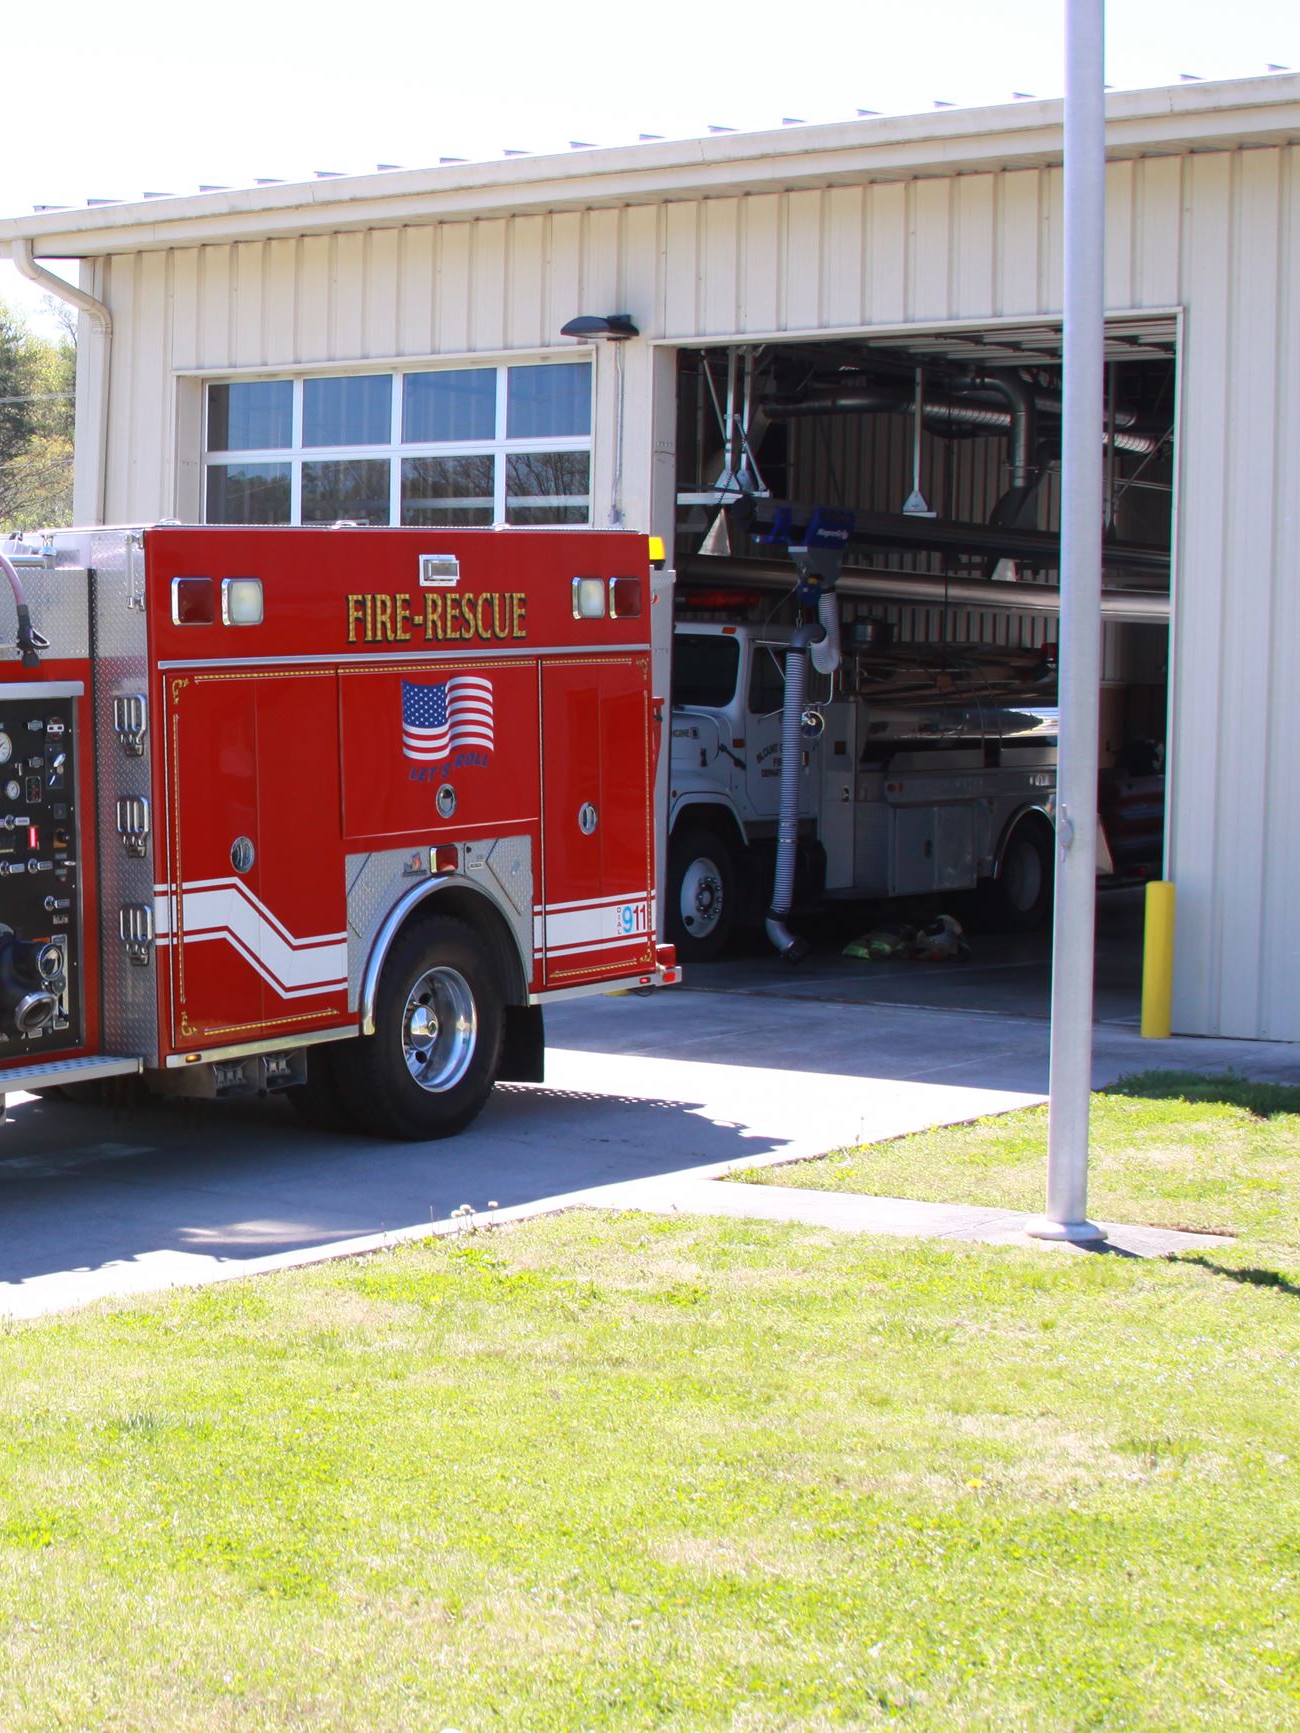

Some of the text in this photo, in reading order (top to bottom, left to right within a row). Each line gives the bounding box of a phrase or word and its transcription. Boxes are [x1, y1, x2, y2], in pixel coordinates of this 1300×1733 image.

[347, 592, 527, 643] FIRE-RESCUE
[454, 752, 489, 768] ROLL
[622, 904, 646, 933] 911
